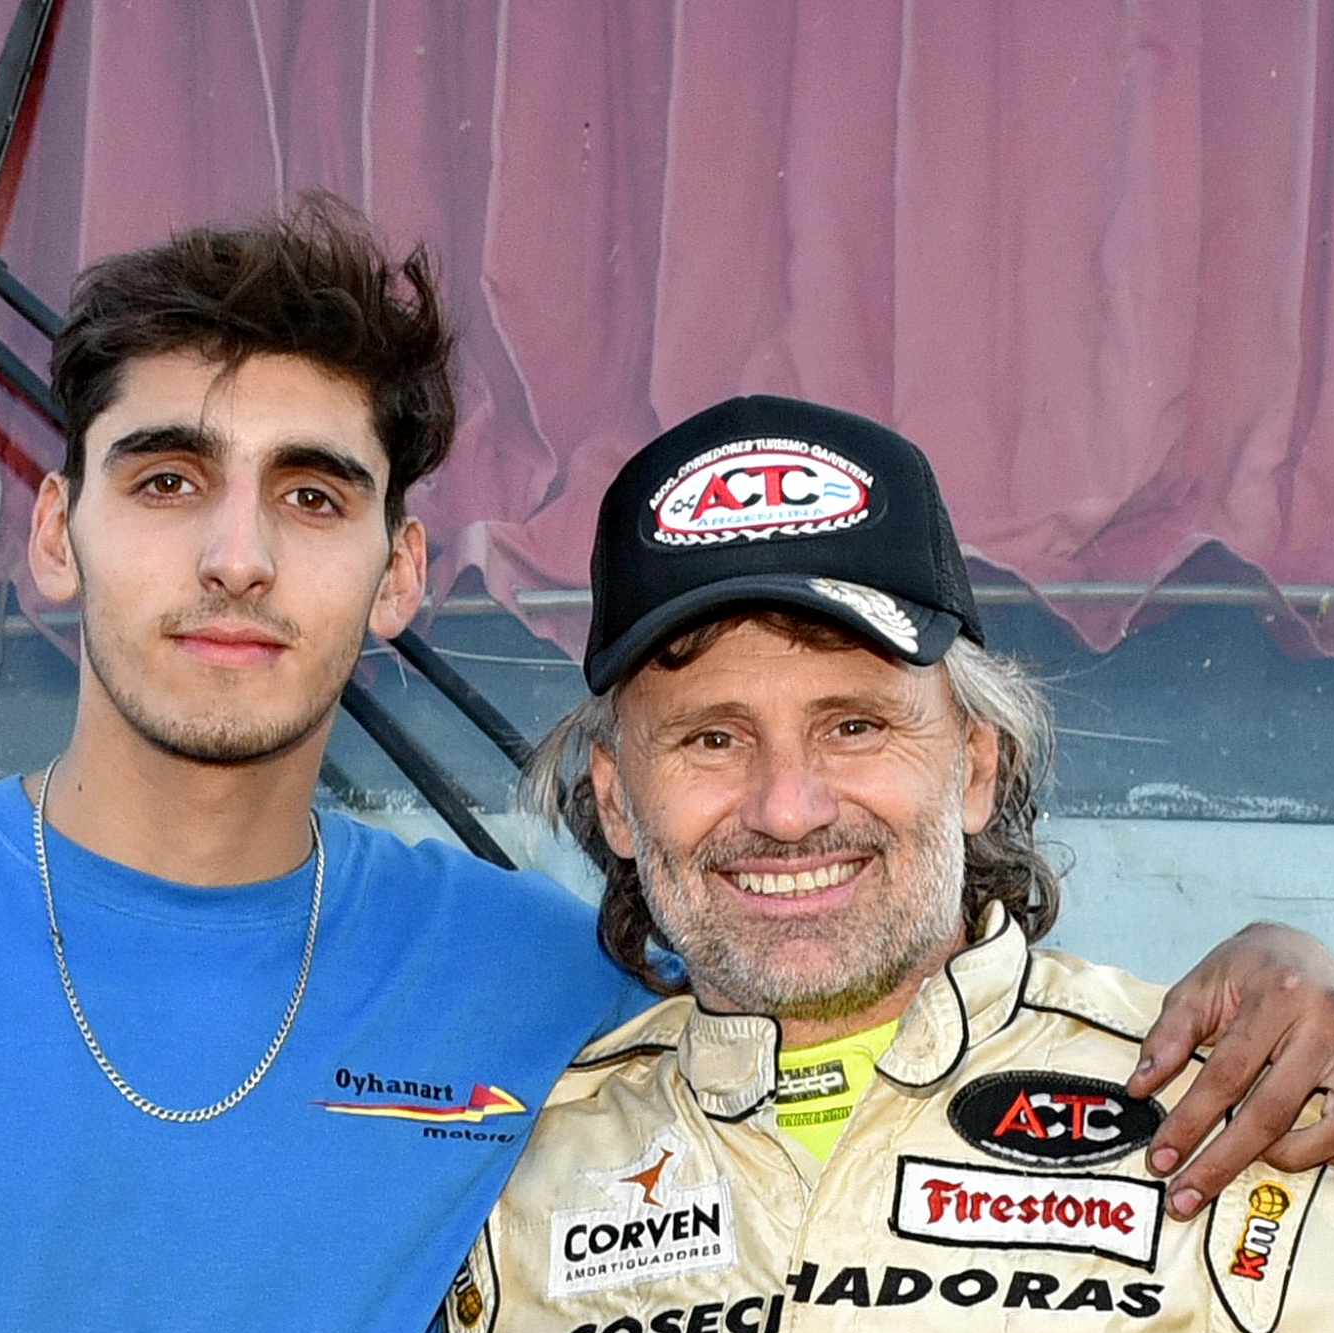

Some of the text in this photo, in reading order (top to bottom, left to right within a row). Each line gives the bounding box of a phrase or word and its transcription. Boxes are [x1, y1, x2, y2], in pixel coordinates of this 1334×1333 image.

[689, 465, 821, 522] ACTC
[696, 507, 825, 527] ARGENTINA
[335, 1068, 454, 1102] Oyhanart
[993, 1089, 1124, 1142] ACTC
[564, 1203, 720, 1263] CORVEN
[920, 1178, 1136, 1235] Firestone
[565, 1243, 722, 1283] AMORTIGUADORES
